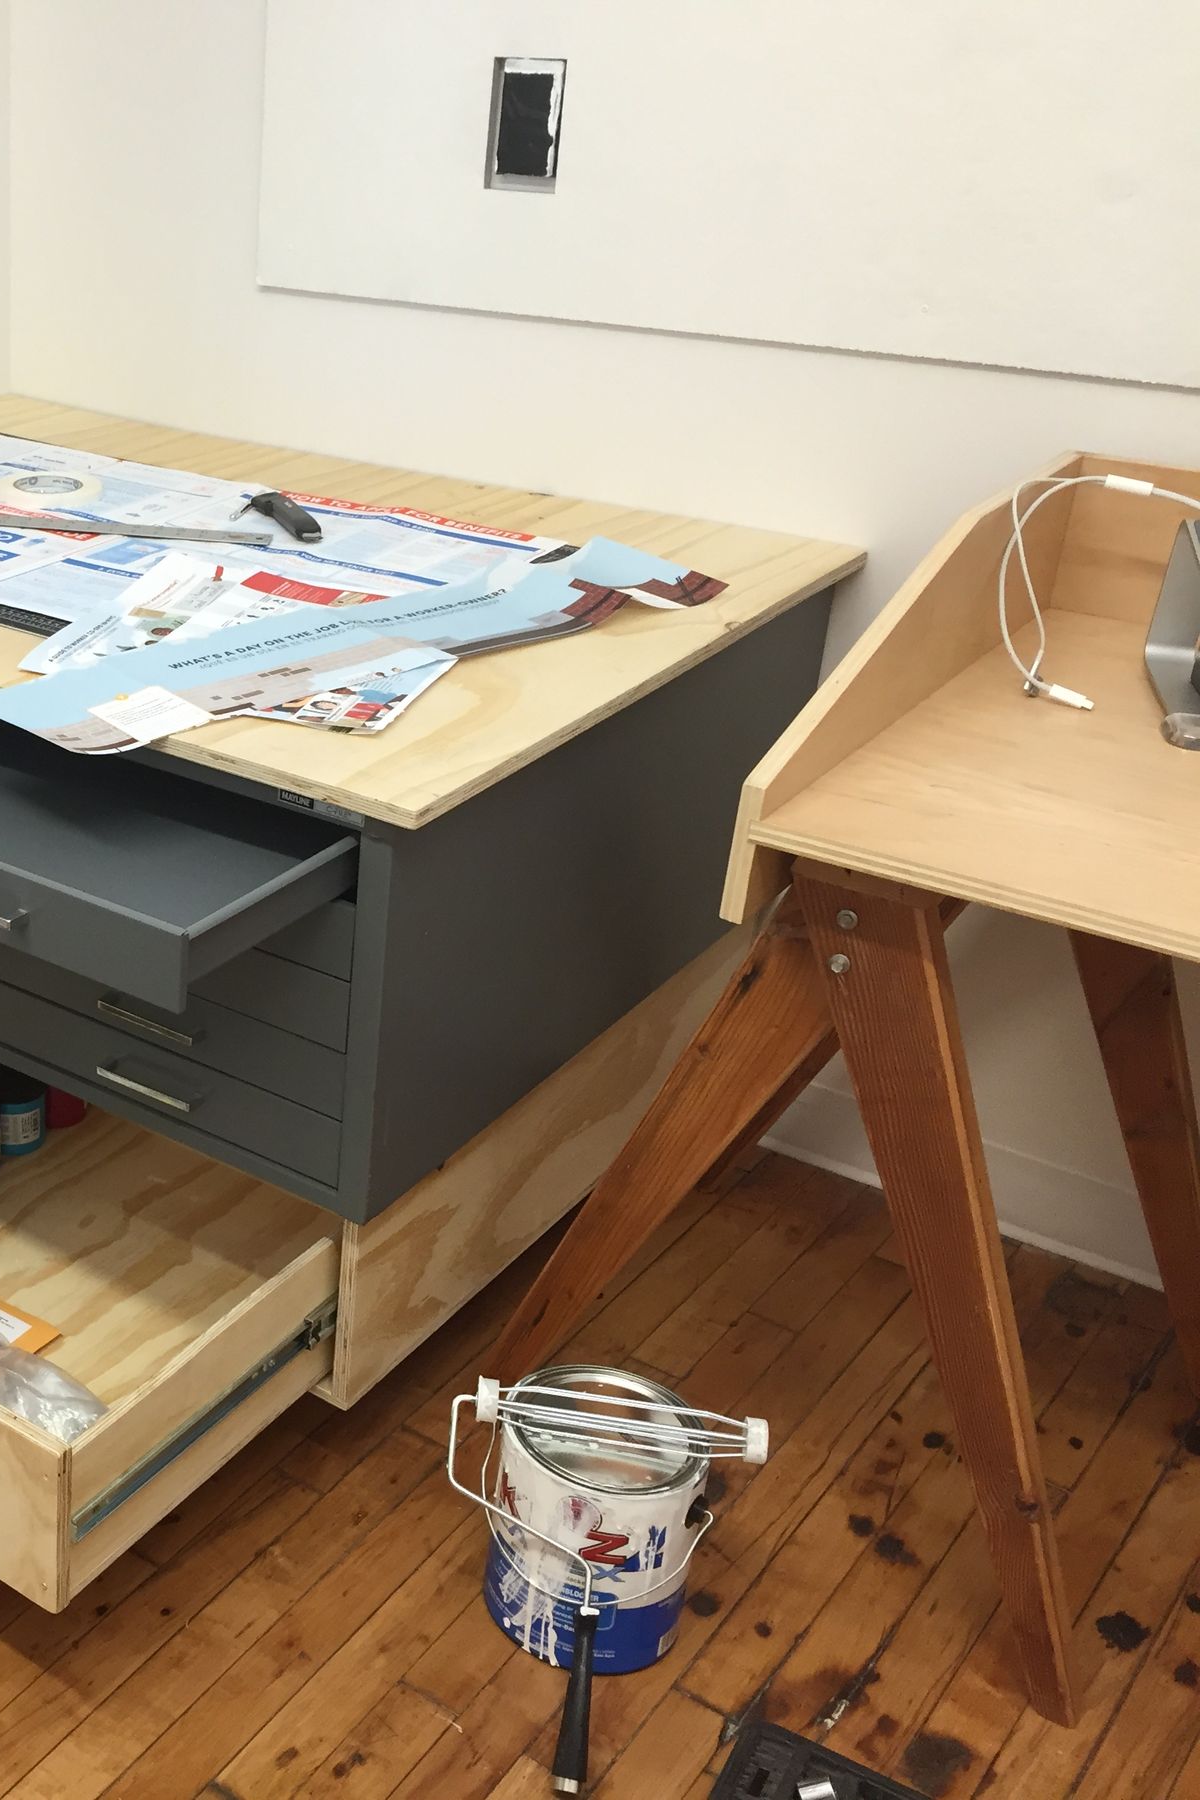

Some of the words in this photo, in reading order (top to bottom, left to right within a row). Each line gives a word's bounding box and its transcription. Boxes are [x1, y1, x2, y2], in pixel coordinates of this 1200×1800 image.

[286, 493, 328, 504] HOW
[329, 500, 351, 509] TO
[406, 509, 440, 524] FOR
[444, 520, 523, 540] BENEFITS
[168, 653, 223, 670] WHAT'S
[235, 643, 262, 654] DAY
[264, 638, 285, 647] ON
[284, 630, 313, 641] THE
[314, 623, 339, 634] JOB
[403, 588, 507, 618] WORKER-OWNER?
[281, 790, 311, 807] MAYLINE
